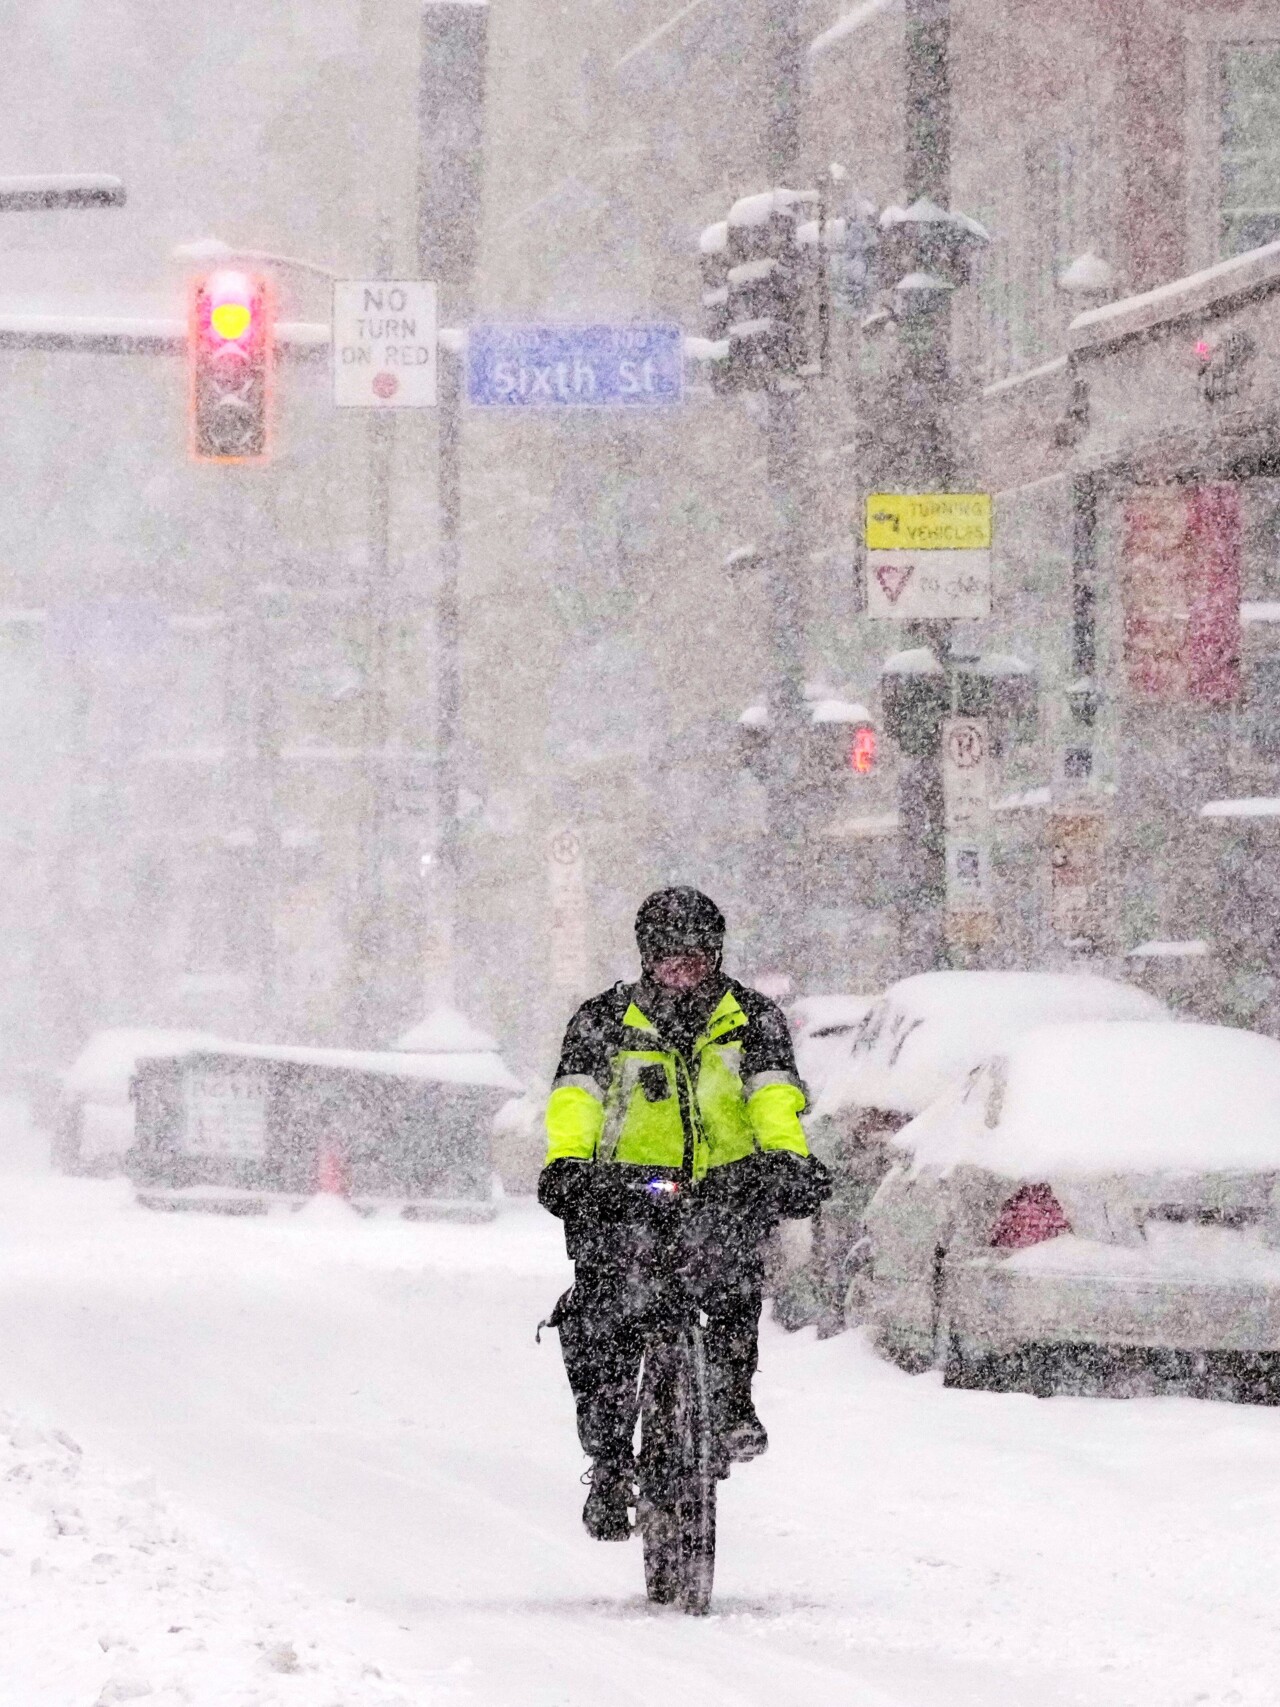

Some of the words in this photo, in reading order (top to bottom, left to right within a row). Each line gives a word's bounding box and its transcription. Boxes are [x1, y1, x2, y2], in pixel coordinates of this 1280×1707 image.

[363, 288, 407, 312] NO
[357, 318, 416, 338] TURN
[342, 346, 371, 366] ON
[384, 346, 429, 366] RED
[494, 358, 596, 394] Sixth
[618, 359, 654, 393] St
[910, 502, 983, 517] TURNING
[907, 526, 984, 541] VEHICLES
